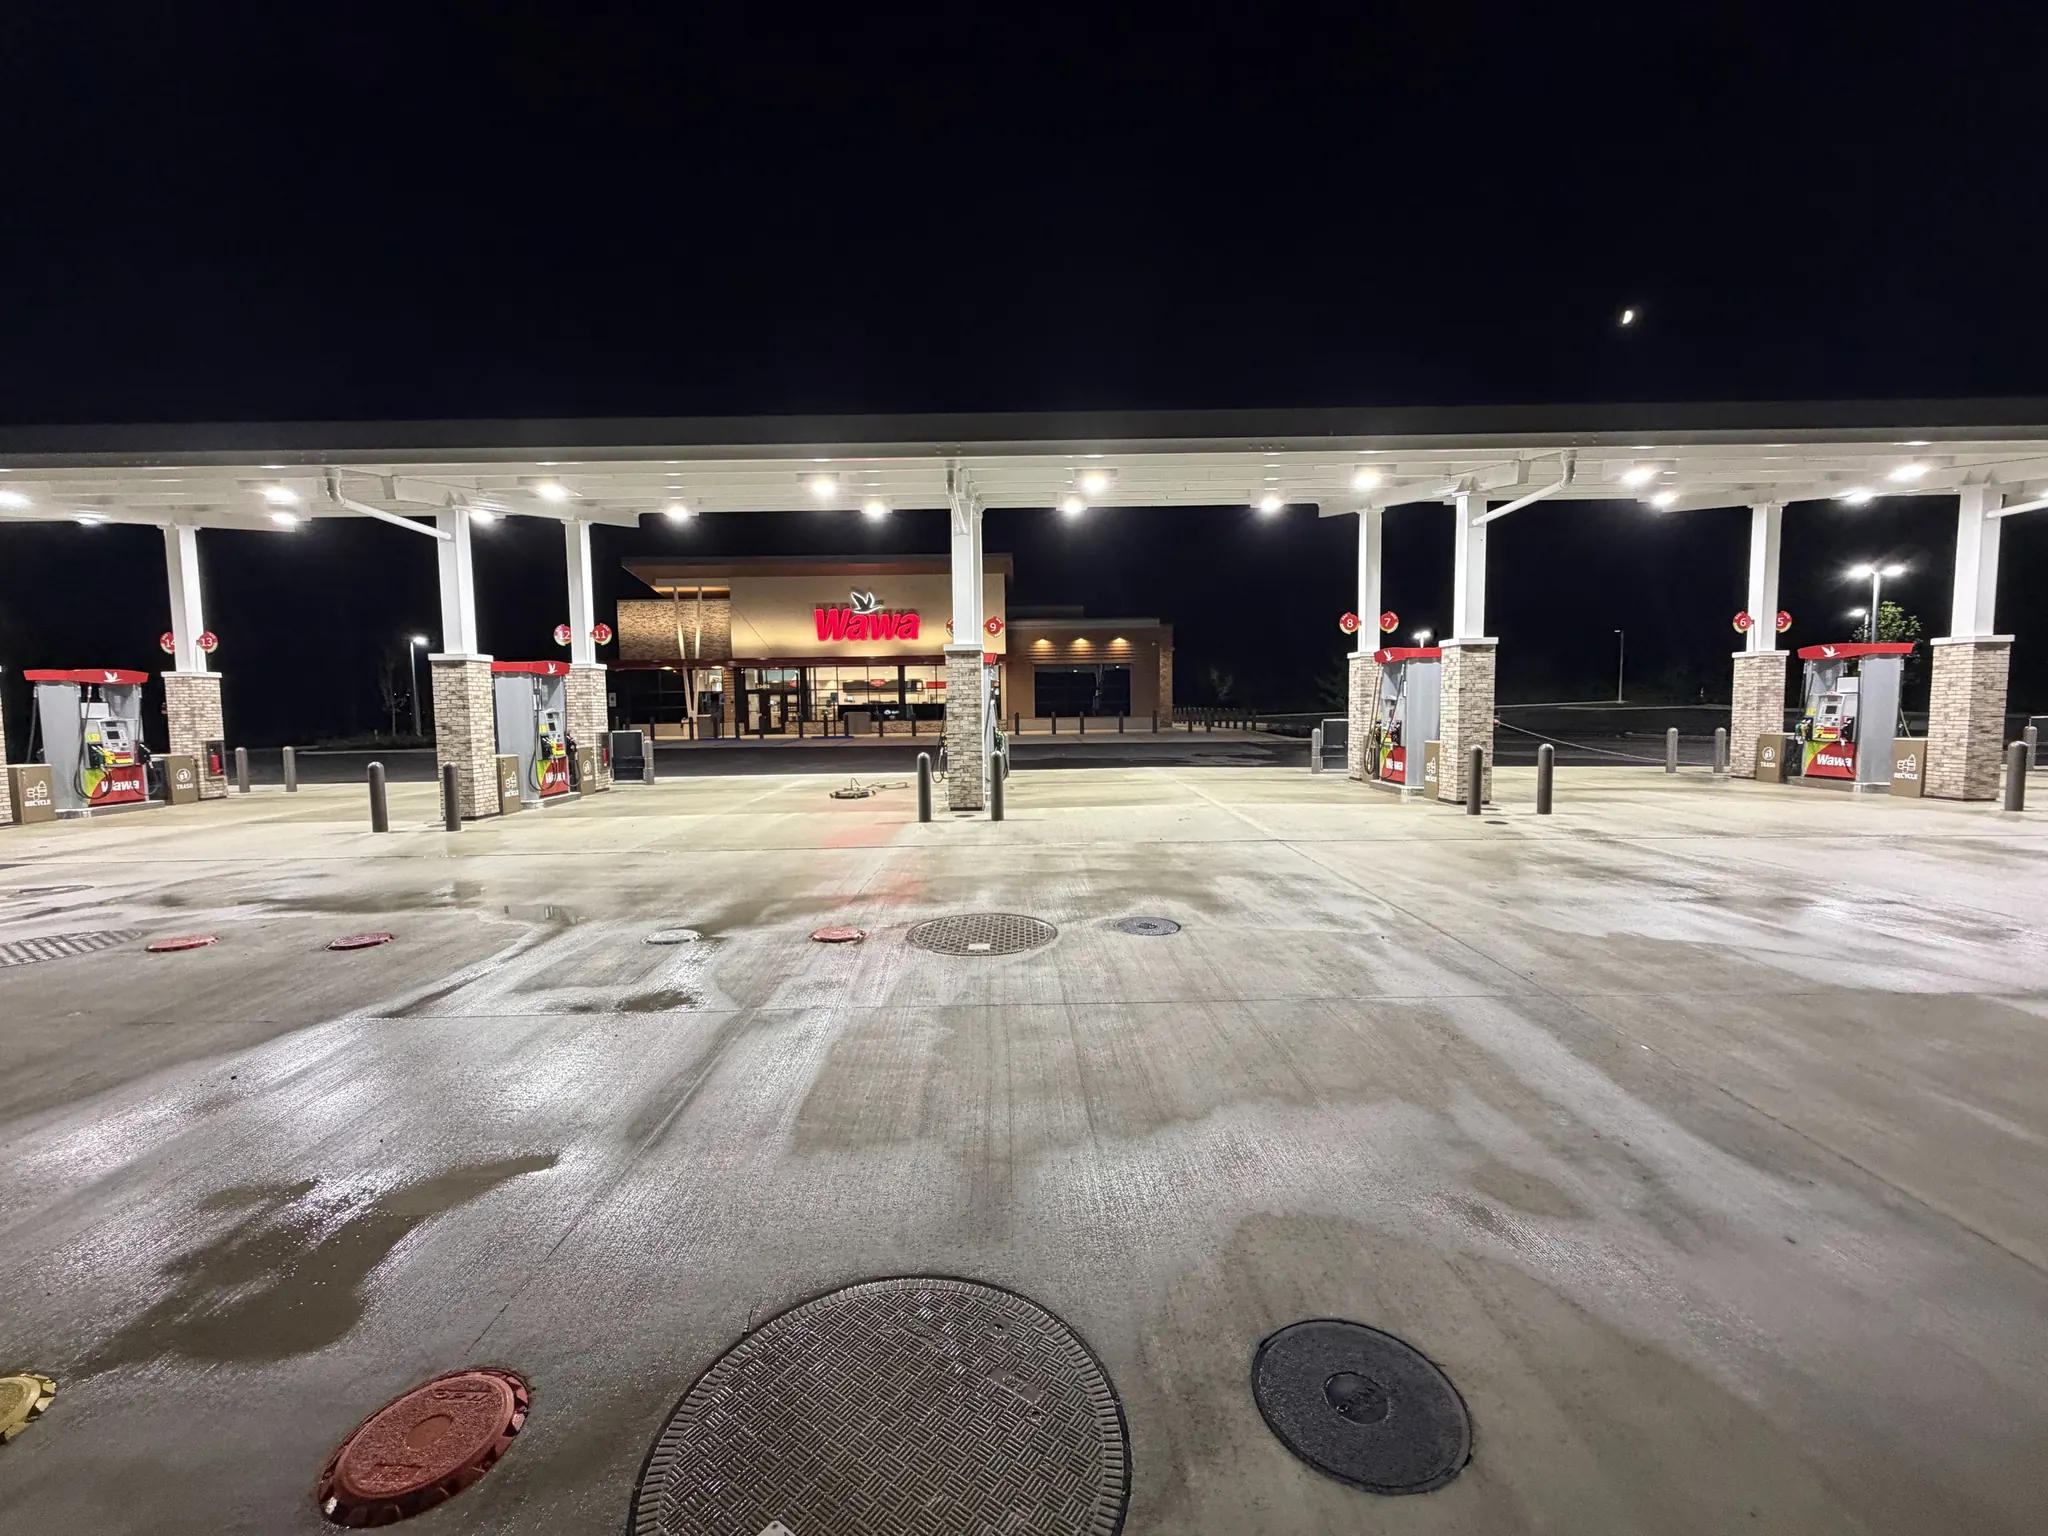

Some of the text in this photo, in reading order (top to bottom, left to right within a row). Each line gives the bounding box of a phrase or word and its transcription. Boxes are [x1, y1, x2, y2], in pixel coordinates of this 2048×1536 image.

[814, 608, 920, 641] Wawa
[989, 622, 997, 632] 9
[1346, 618, 1354, 628] 8
[1384, 617, 1391, 627] 7
[1740, 617, 1747, 627] 6
[1776, 617, 1785, 627] 5
[559, 630, 571, 640] 12
[594, 630, 606, 639] 11
[200, 637, 213, 647] 13
[1816, 754, 1853, 767] Wawa
[176, 782, 194, 790] TRASH
